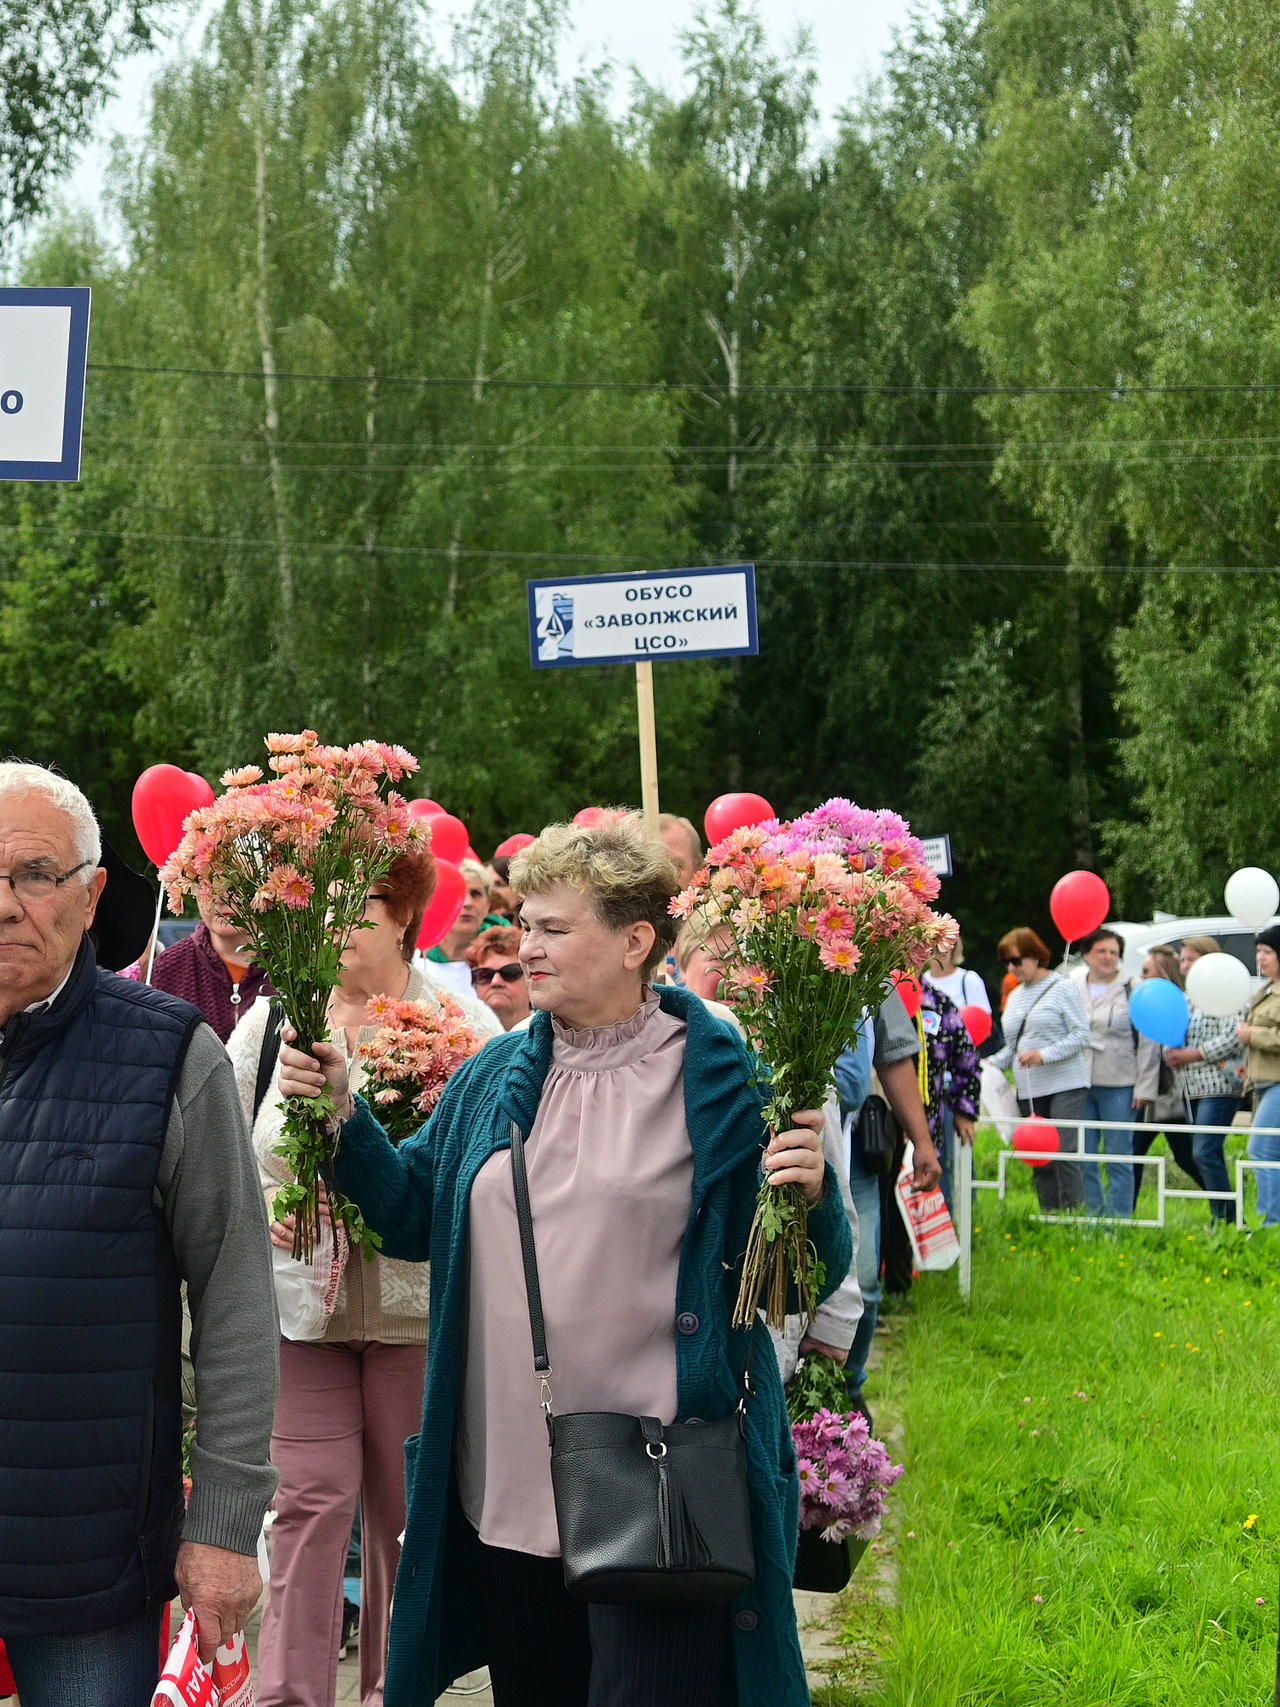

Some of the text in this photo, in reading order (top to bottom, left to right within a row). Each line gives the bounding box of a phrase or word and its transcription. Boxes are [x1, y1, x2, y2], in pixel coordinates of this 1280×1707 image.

[625, 584, 693, 602] ОБУСО
[584, 602, 738, 628] «ЗАВОЛЖСКИЙ
[635, 635, 688, 654] ЦСО»
